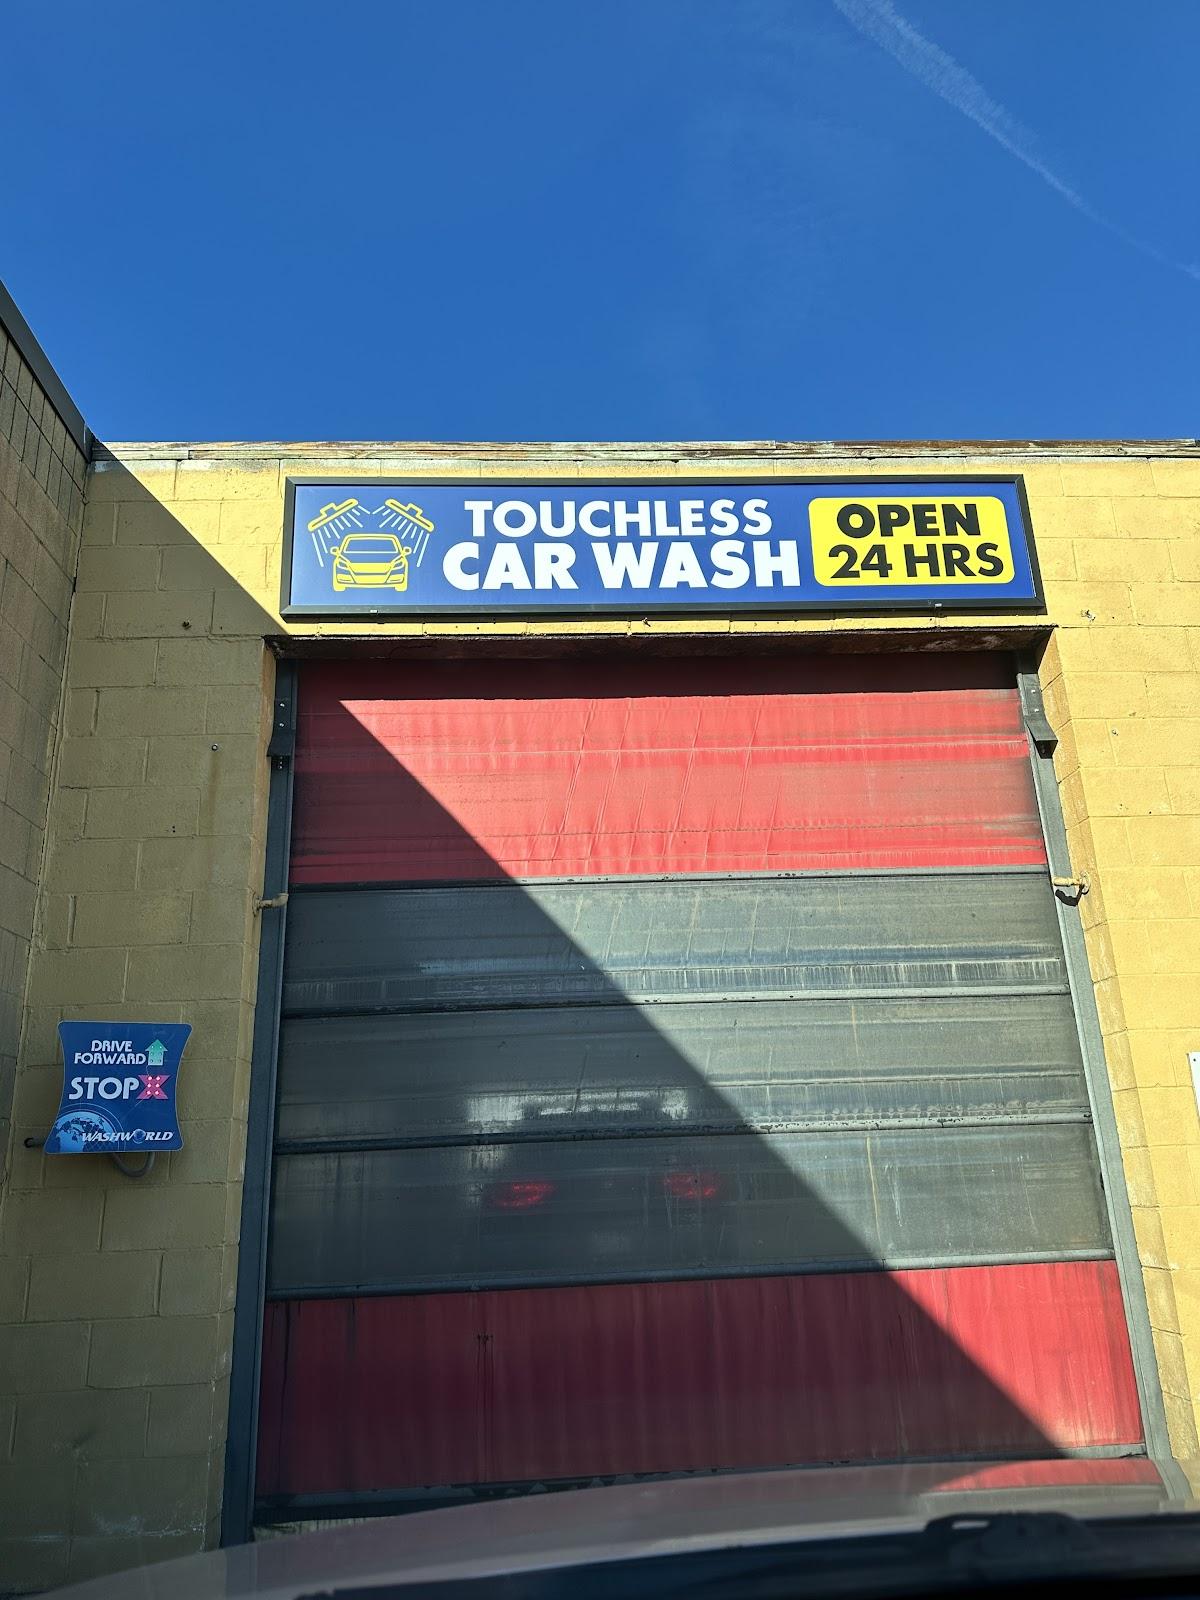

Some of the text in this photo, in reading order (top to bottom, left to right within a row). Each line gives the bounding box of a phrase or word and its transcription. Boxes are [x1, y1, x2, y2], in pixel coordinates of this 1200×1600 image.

[464, 499, 773, 539] TOUCHLESS
[836, 503, 982, 538] OPEN
[443, 540, 801, 591] CAR WASH
[828, 541, 1004, 579] 24 HRS
[74, 1053, 146, 1065] FORWARD
[91, 1040, 133, 1052] DRIVE
[68, 1077, 140, 1100] STOP
[82, 1129, 174, 1144] WASHWORLD
